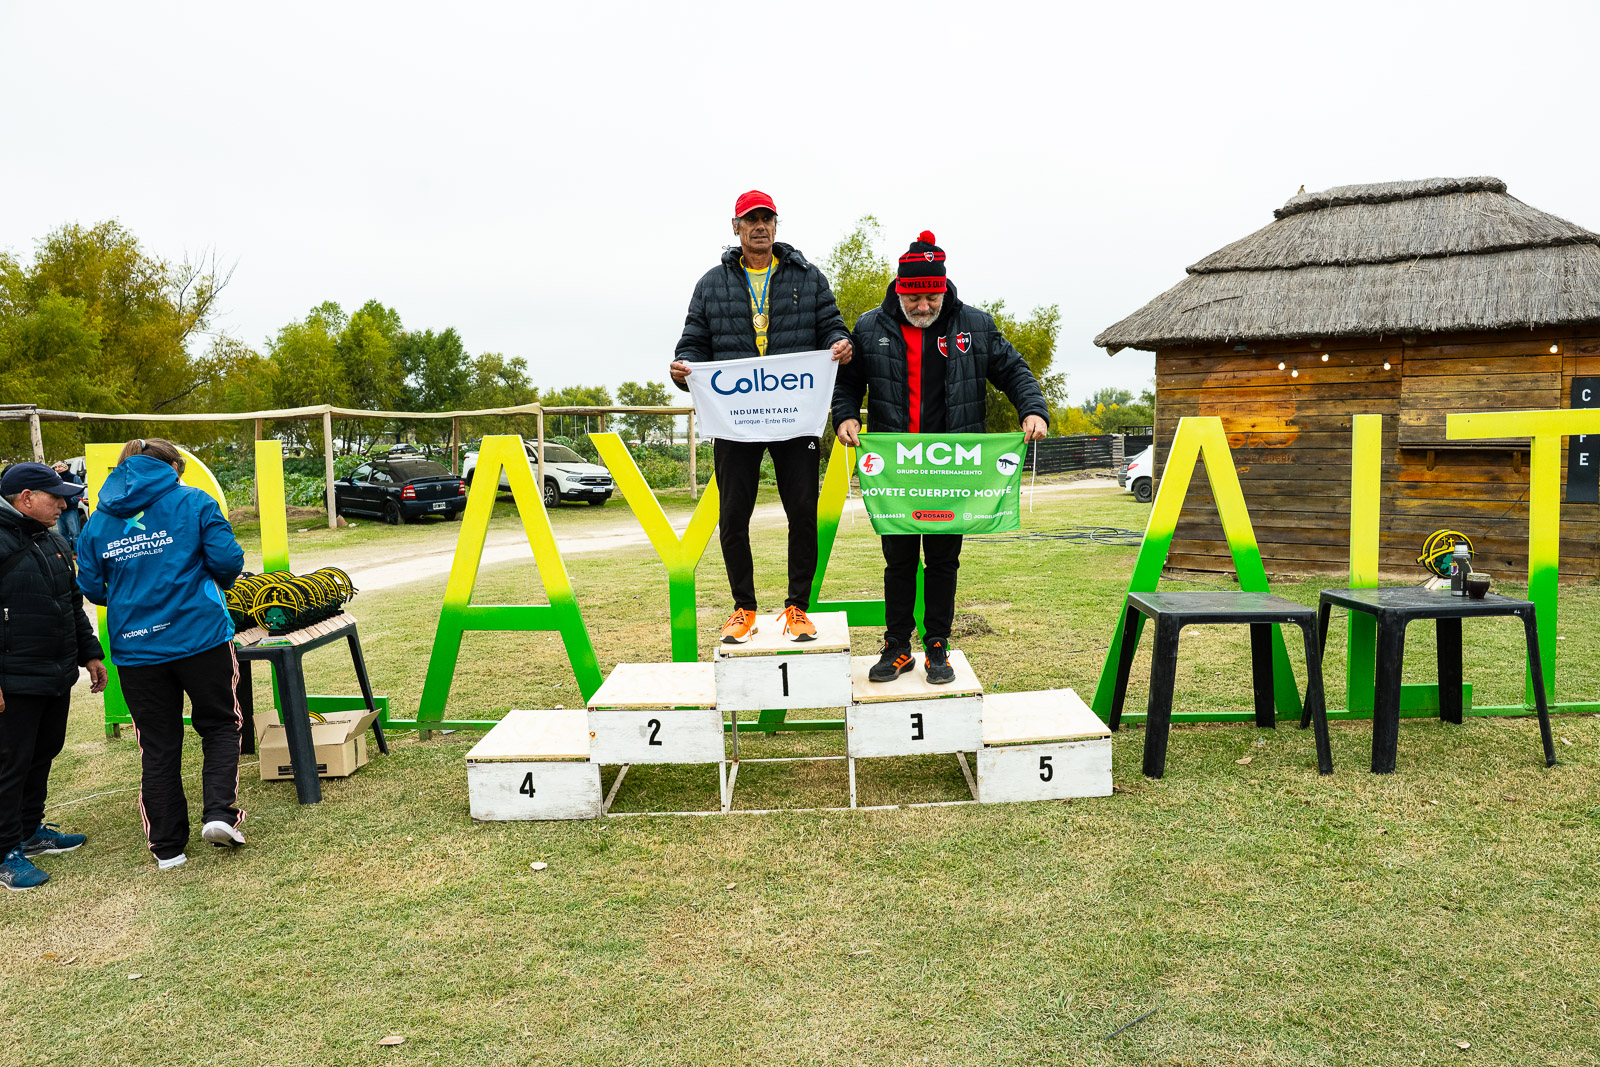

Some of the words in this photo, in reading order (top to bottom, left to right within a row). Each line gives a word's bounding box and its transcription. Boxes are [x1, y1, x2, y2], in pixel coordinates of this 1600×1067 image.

[711, 368, 814, 395] Colben
[730, 407, 799, 416] INDUMENTARIA
[1579, 388, 1592, 466] CFE
[896, 441, 982, 466] MCM
[861, 487, 906, 497] MOVETE
[909, 487, 971, 498] CUERPITO
[102, 536, 174, 559] DEPORTIVAS
[107, 530, 167, 550] ESCUELAS
[115, 547, 164, 562] MUNICIPALES
[777, 662, 789, 697] 1
[647, 718, 663, 746] 2
[910, 713, 924, 741] 3
[1039, 755, 1054, 782] 5
[519, 771, 536, 798] 4
